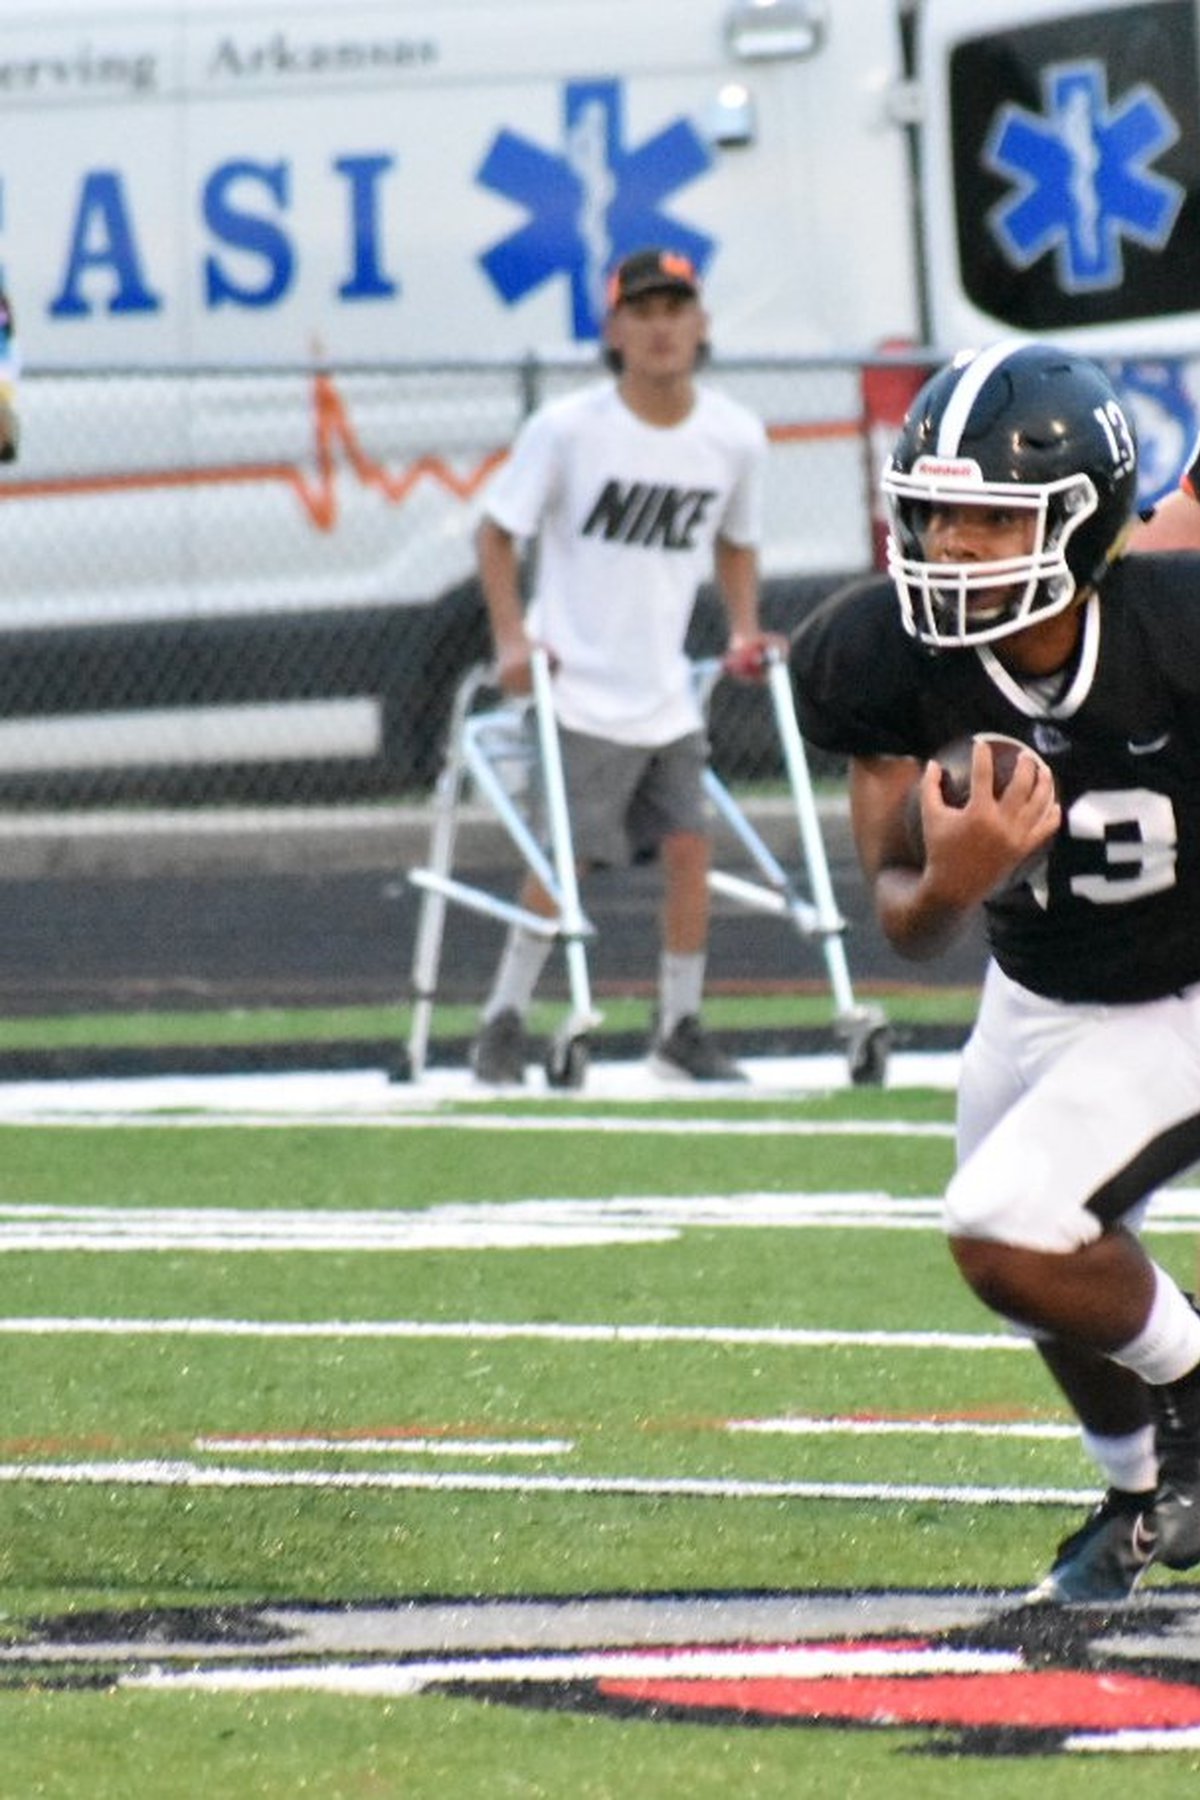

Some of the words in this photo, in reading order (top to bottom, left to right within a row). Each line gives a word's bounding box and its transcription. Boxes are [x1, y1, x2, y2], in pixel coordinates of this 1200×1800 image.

[205, 33, 440, 77] Arkansas
[0, 154, 398, 318] ASI
[1093, 399, 1136, 481] 13
[581, 480, 718, 549] NIKE
[1006, 788, 1179, 909] 3
